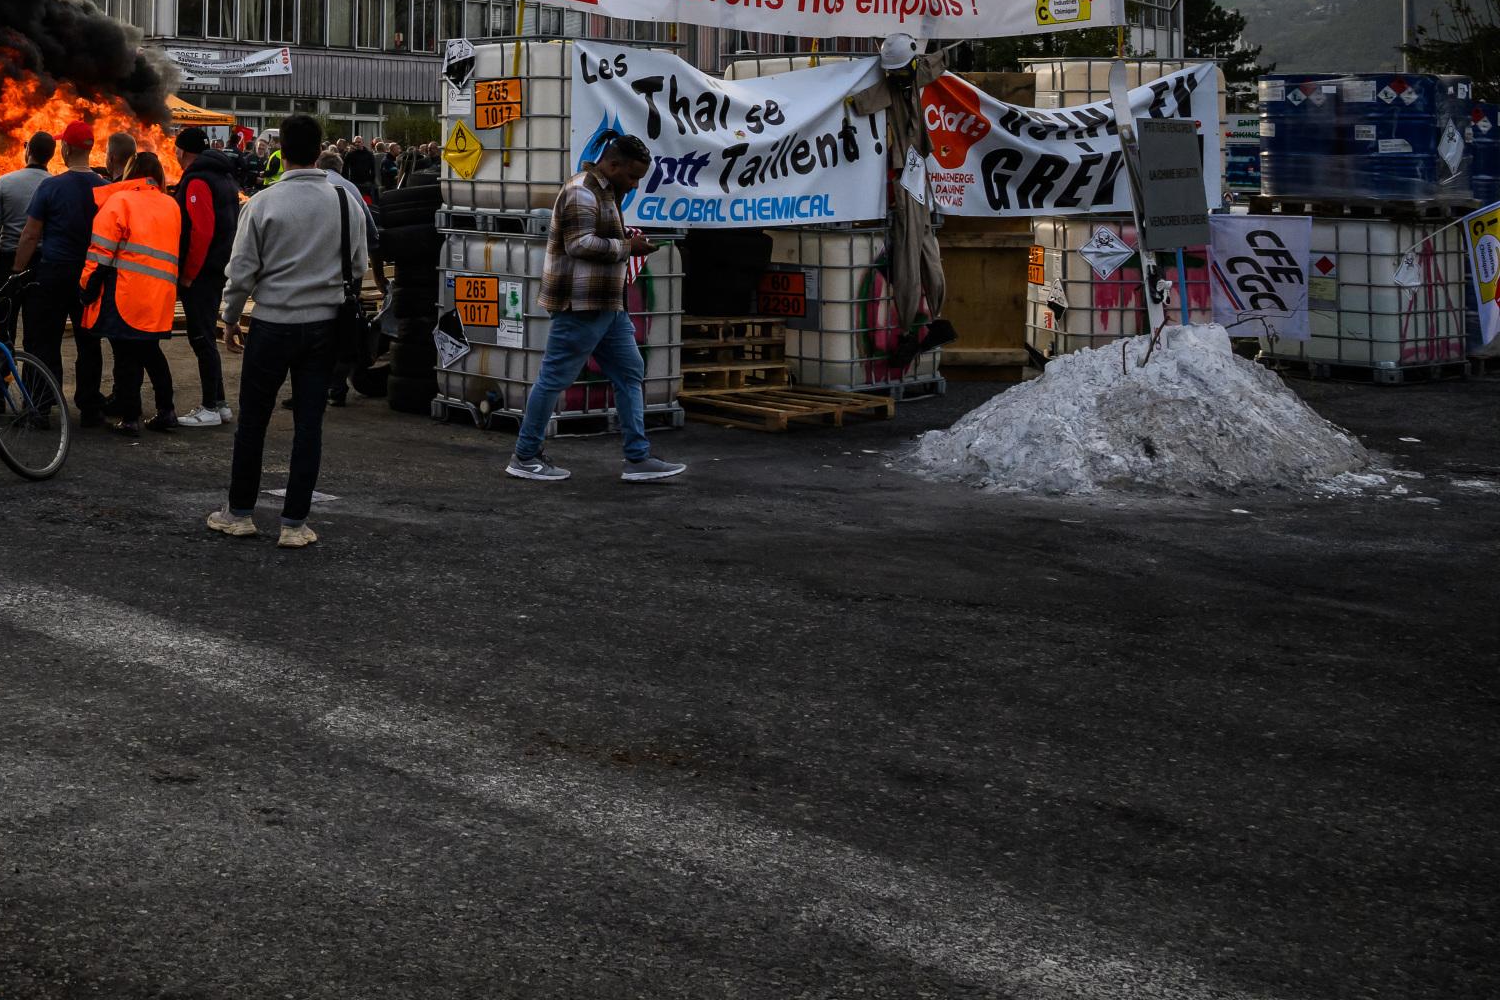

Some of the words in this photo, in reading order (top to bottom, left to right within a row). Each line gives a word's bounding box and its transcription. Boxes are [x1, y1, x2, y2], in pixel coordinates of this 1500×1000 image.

[581, 52, 627, 84] Les
[487, 83, 508, 101] 265
[1000, 102, 1119, 140] USIN
[1149, 72, 1199, 118] EN
[485, 107, 511, 125] 1017
[745, 99, 785, 134] se
[719, 117, 859, 193] Taillent
[981, 142, 1204, 212] GRÈV
[637, 196, 729, 222] GLOBAL
[730, 194, 834, 221] CHEMICAL
[1246, 229, 1304, 285] CFE
[466, 281, 486, 298] 265
[771, 275, 790, 291] 60
[1226, 256, 1287, 311] CGC
[464, 304, 489, 322] 1017
[763, 297, 800, 314] 2290
